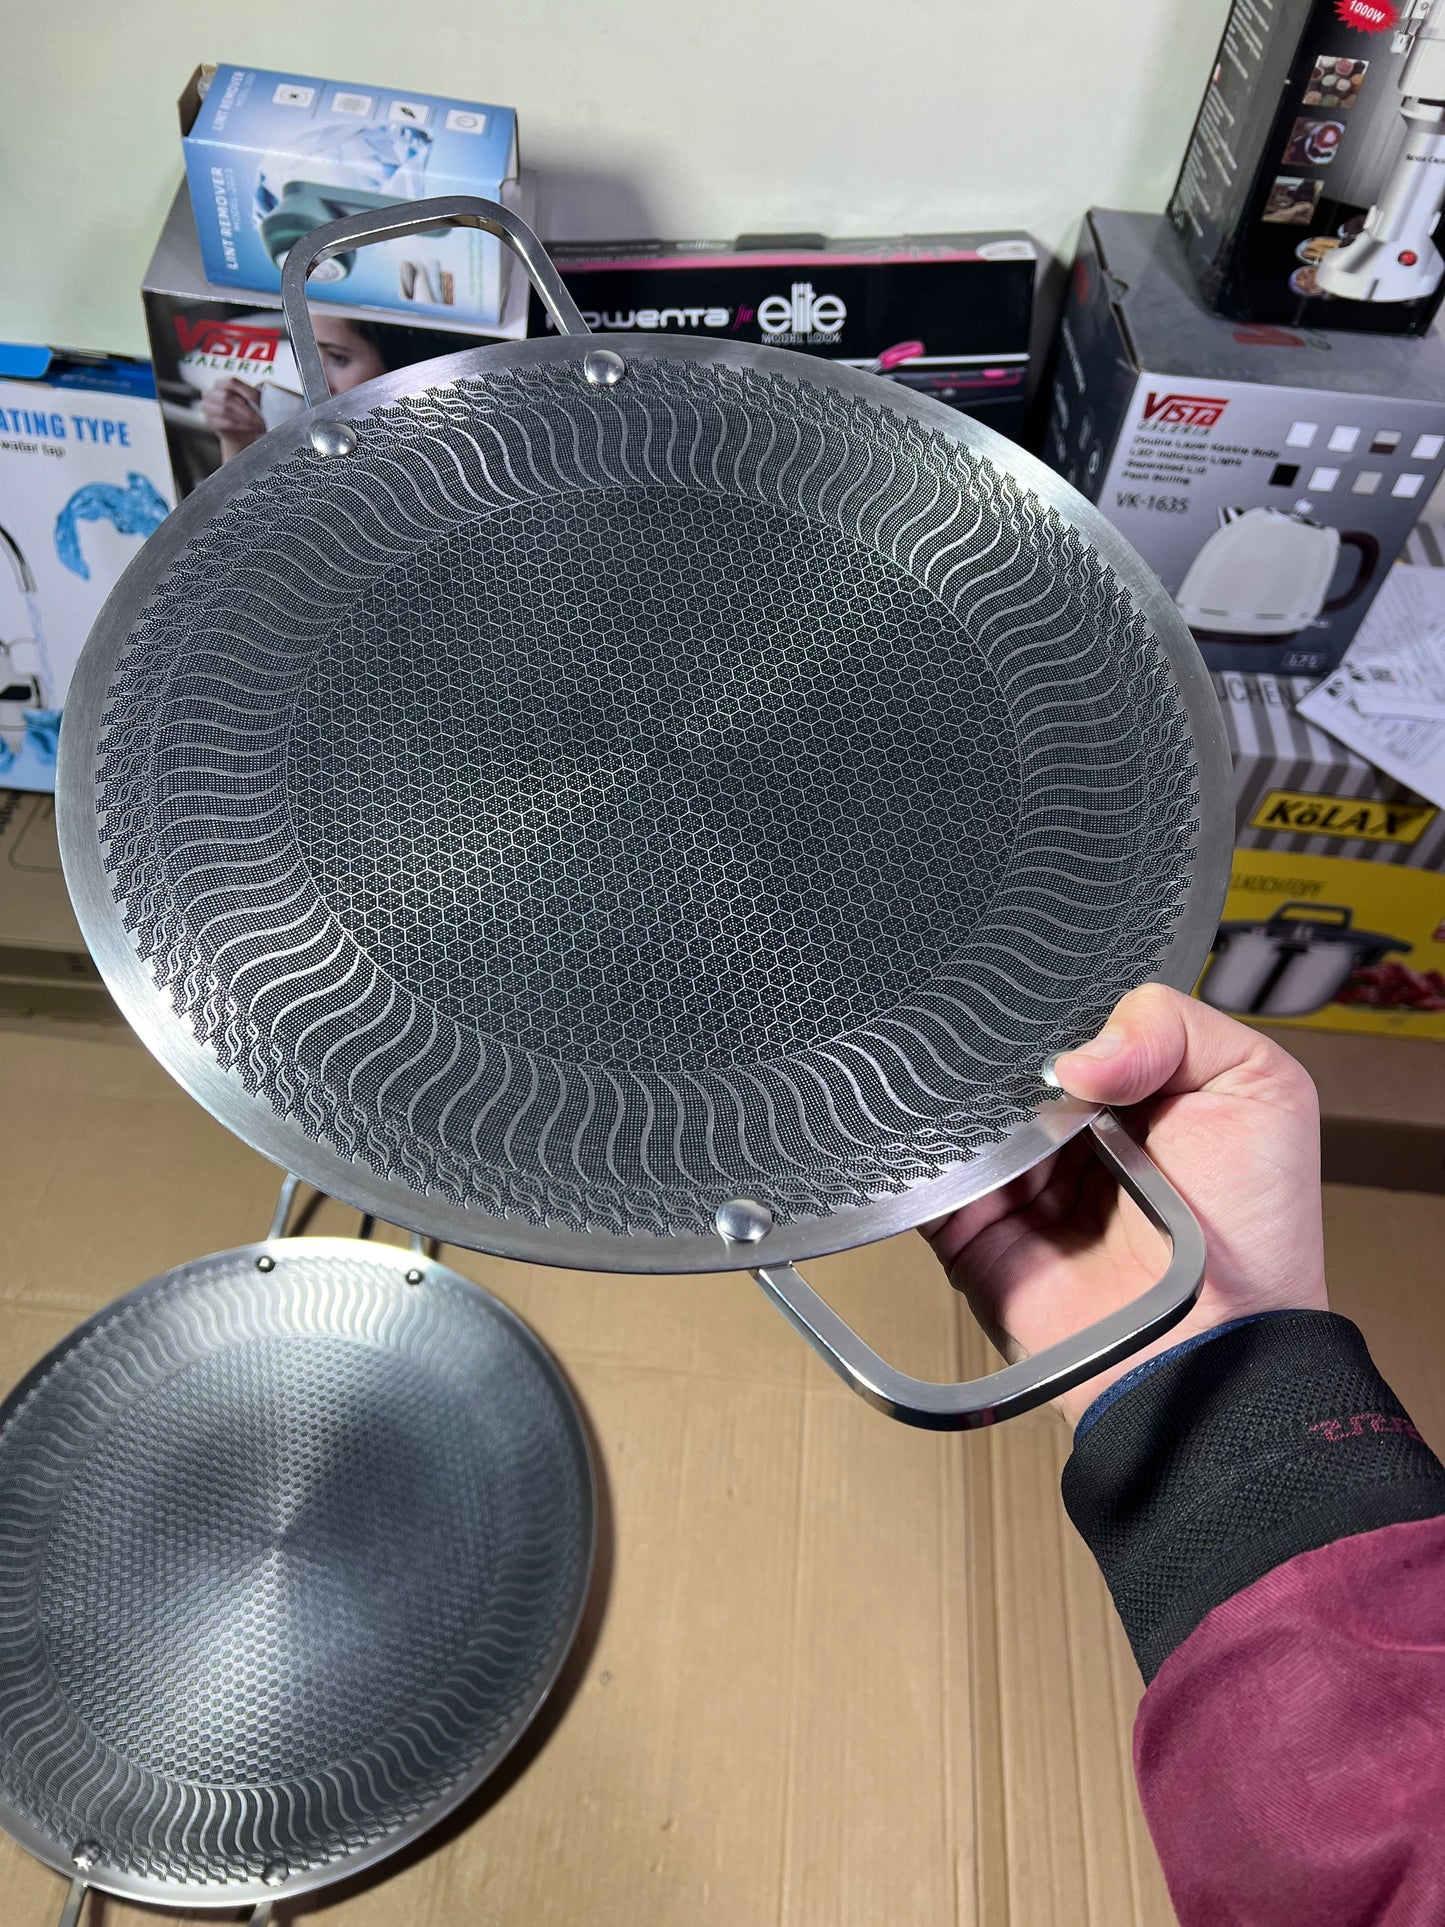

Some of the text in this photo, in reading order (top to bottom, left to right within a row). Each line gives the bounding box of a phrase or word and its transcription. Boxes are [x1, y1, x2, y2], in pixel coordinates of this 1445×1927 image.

[1350, 0, 1385, 23] 1000W
[211, 166, 239, 271] LINT REMOVER
[757, 282, 847, 334] elite
[807, 332, 842, 344] LOOK
[181, 354, 275, 375] GALERIA
[1143, 392, 1231, 427] VISTA
[70, 416, 132, 447] TYPE
[1116, 491, 1191, 514] VK-1635
